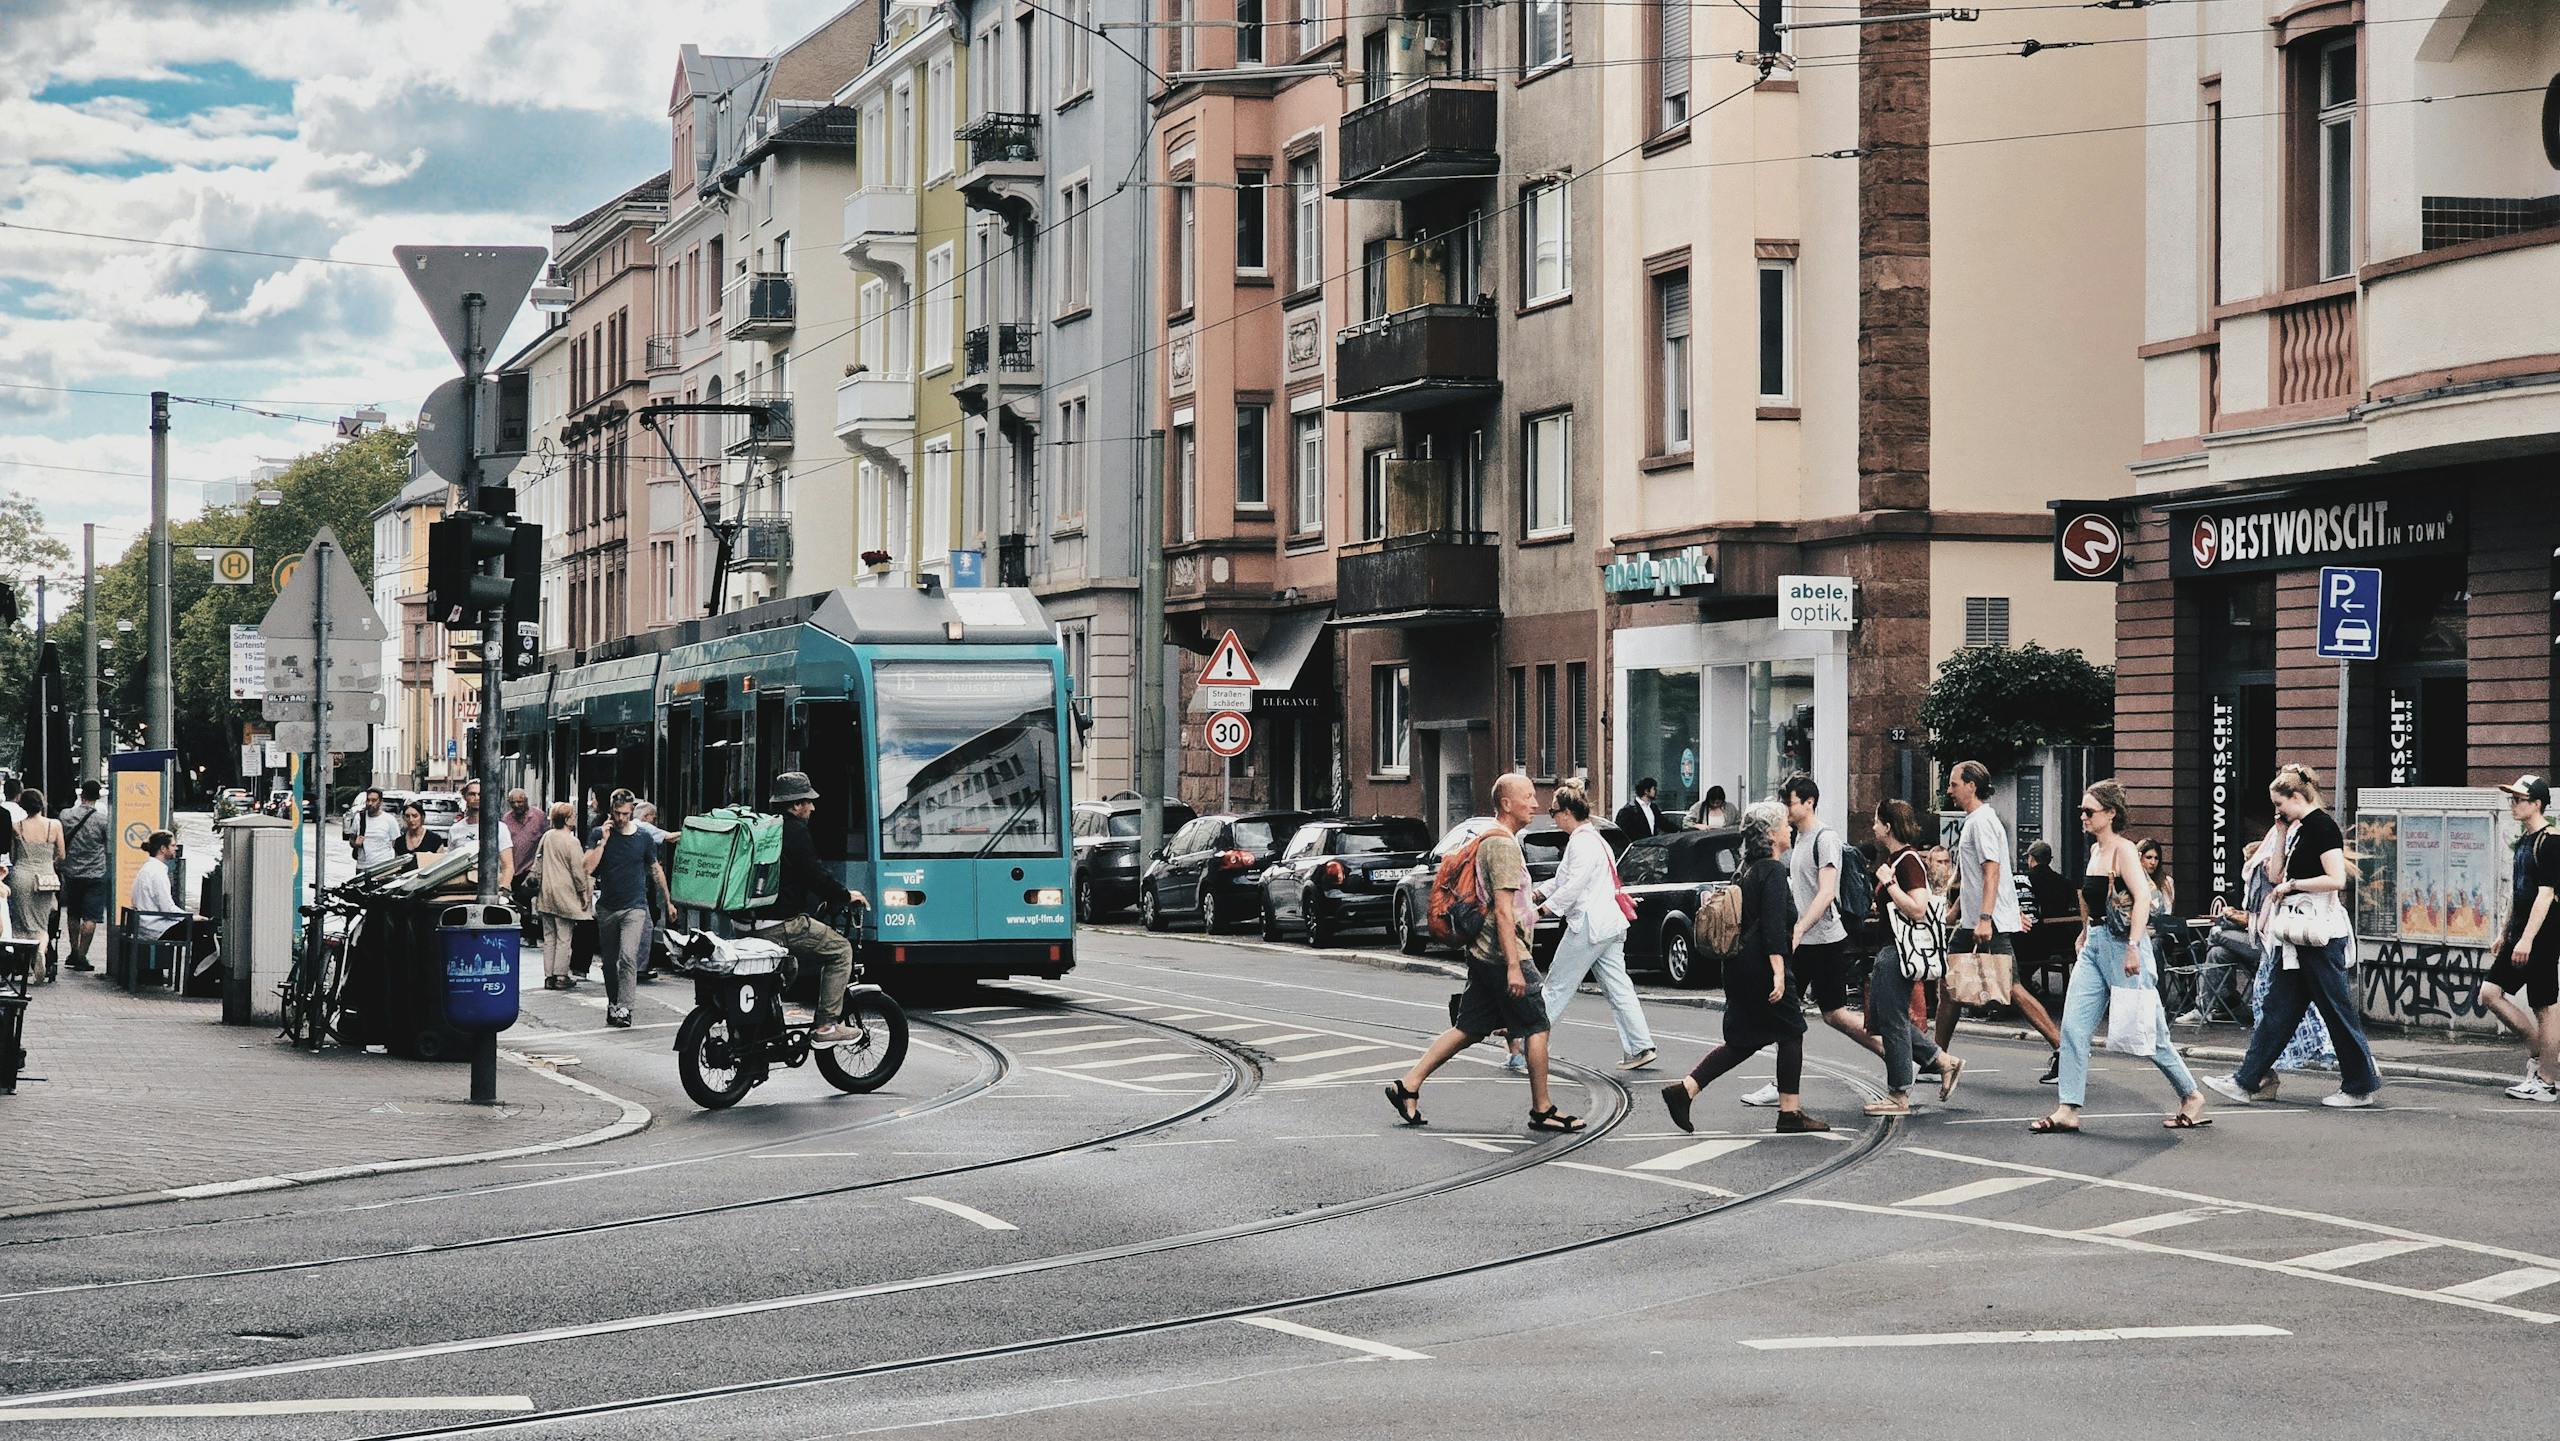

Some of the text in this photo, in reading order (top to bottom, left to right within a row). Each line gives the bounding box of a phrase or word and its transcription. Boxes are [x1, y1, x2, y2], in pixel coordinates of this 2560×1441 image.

[2221, 501, 2446, 561] BESTWORSCHT IN TOWN
[1790, 583, 1848, 602] abele,
[2330, 574, 2356, 608] P
[1790, 603, 1848, 625] optik.
[1212, 690, 1246, 698] Straßen-
[457, 702, 482, 717] PIZZ
[1213, 699, 1245, 707] schäden
[1215, 723, 1241, 743] 30
[1891, 729, 1905, 741] 32
[2213, 702, 2226, 892] BESTWORSCHT
[903, 869, 925, 884] VGF
[884, 913, 916, 926] 029 A
[1006, 915, 1065, 925] www.vgf-ffm.de
[482, 982, 501, 991] FES
